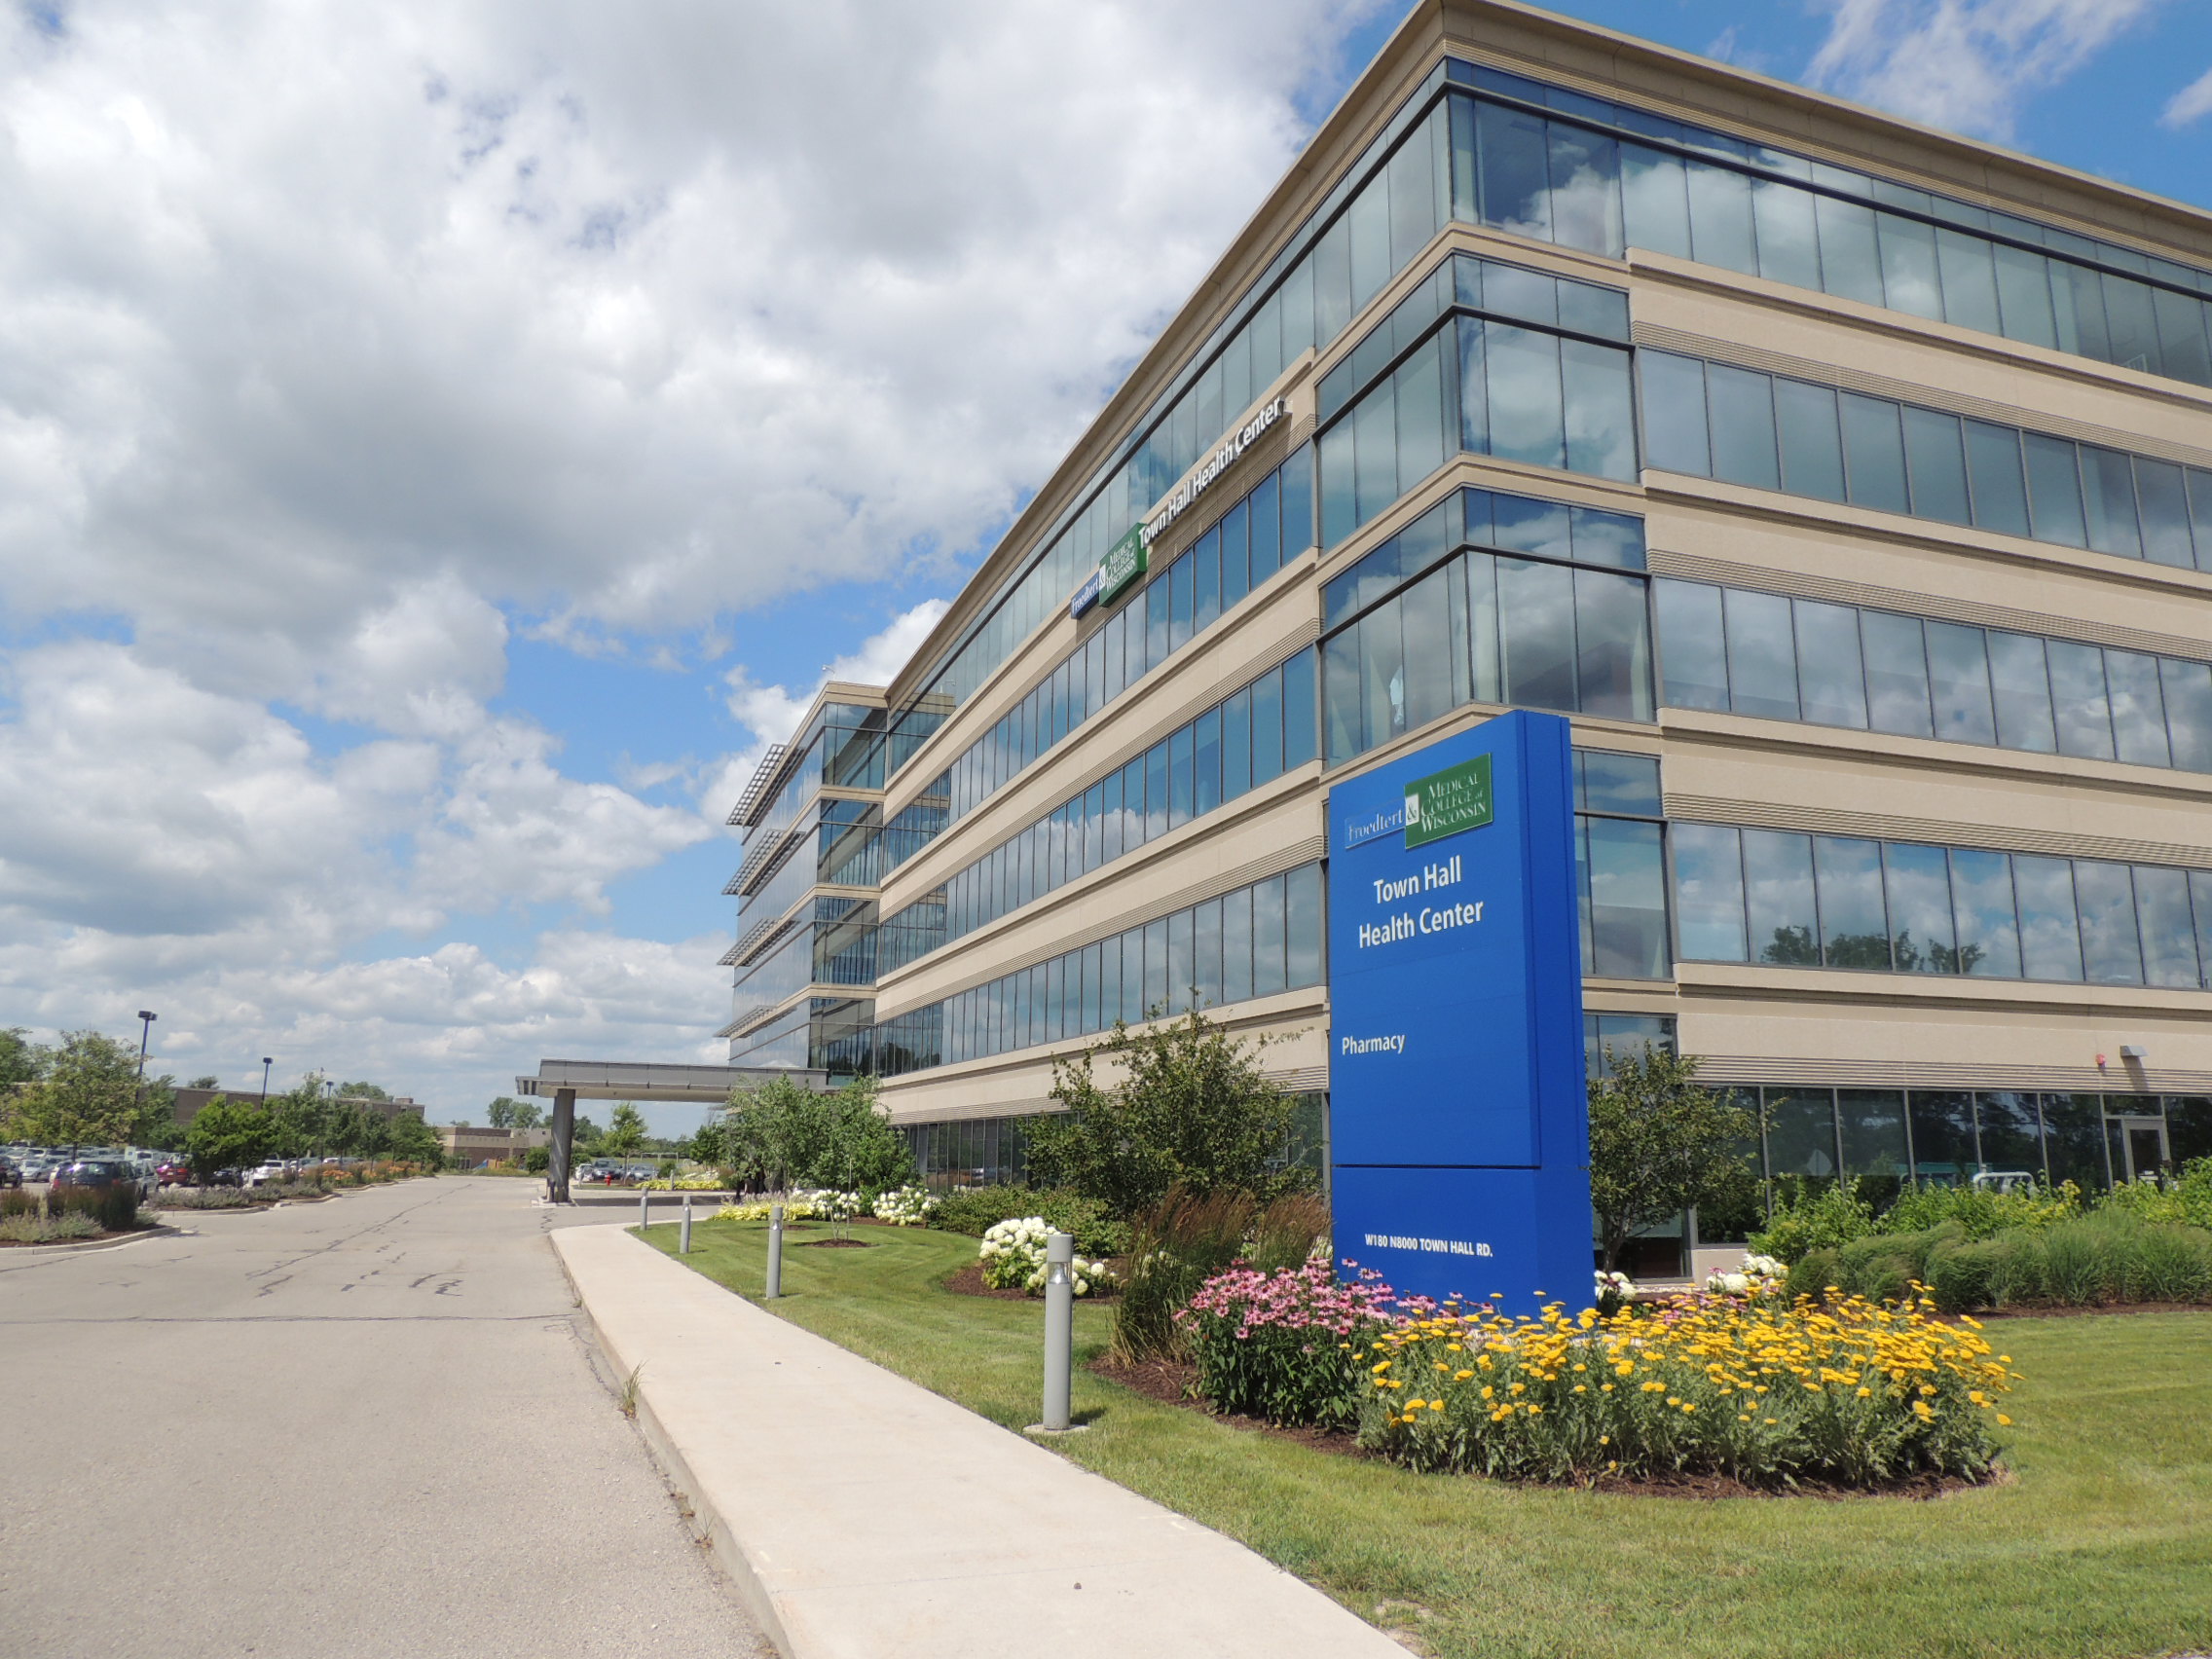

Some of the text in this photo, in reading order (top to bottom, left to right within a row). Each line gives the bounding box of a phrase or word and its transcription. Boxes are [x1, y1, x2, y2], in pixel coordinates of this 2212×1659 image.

[1138, 396, 1281, 549] Town Hall Health Center
[1106, 551, 1130, 576] COLLEGE
[1110, 537, 1134, 565] MEDICAL
[1106, 557, 1136, 592] WISCONSIN
[1072, 577, 1099, 615] Froedtert
[1420, 789, 1472, 816] COLLEGE
[1428, 772, 1479, 803] MEDICAL
[1348, 801, 1418, 841] Froedtert &
[1421, 801, 1487, 833] WISCONSIN
[1374, 855, 1462, 903] Town Hall
[1359, 901, 1484, 948] Health Center
[1342, 1034, 1406, 1055] Pharmacy
[1365, 1234, 1493, 1257] W180 N8000 TOWN HALL RD.
